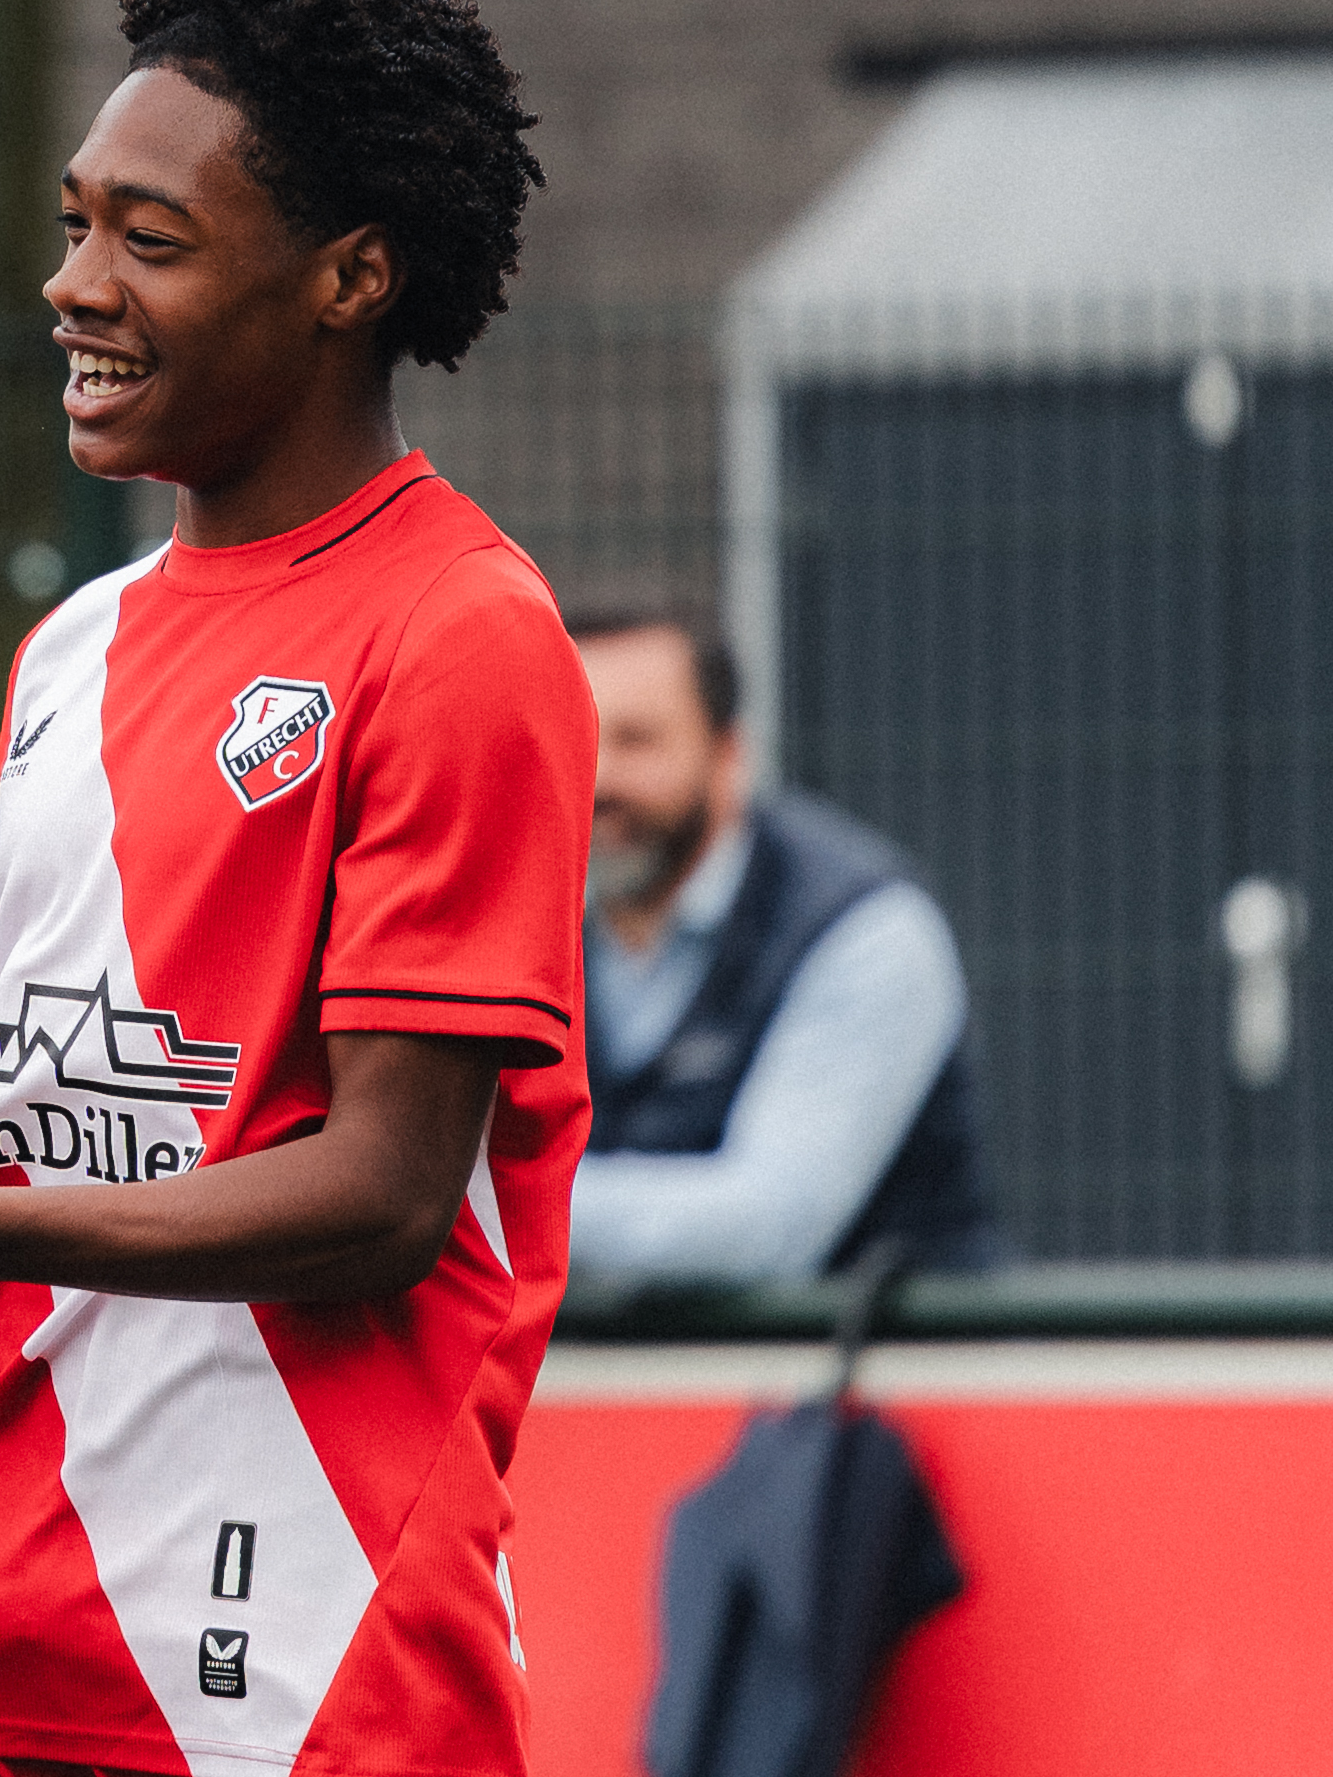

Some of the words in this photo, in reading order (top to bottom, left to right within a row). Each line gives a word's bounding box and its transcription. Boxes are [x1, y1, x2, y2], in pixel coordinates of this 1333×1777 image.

[257, 696, 279, 725] F
[229, 696, 324, 778] UTRECHT
[272, 749, 300, 780] C
